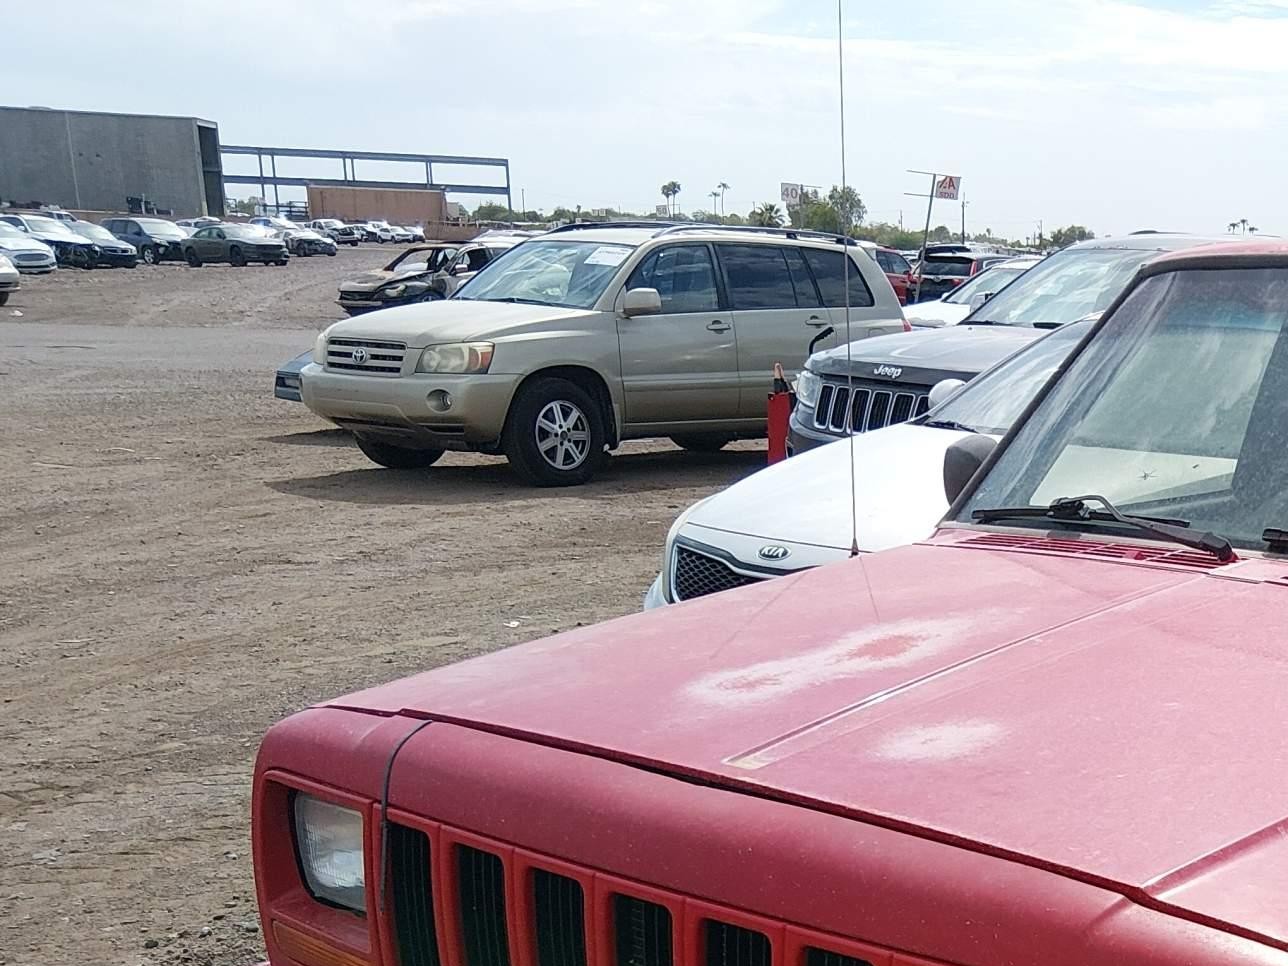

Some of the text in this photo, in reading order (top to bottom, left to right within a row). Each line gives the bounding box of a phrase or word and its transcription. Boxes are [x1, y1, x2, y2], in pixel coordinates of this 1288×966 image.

[783, 186, 798, 200] 40
[873, 364, 902, 379] Jeep
[760, 545, 785, 558] KIA
